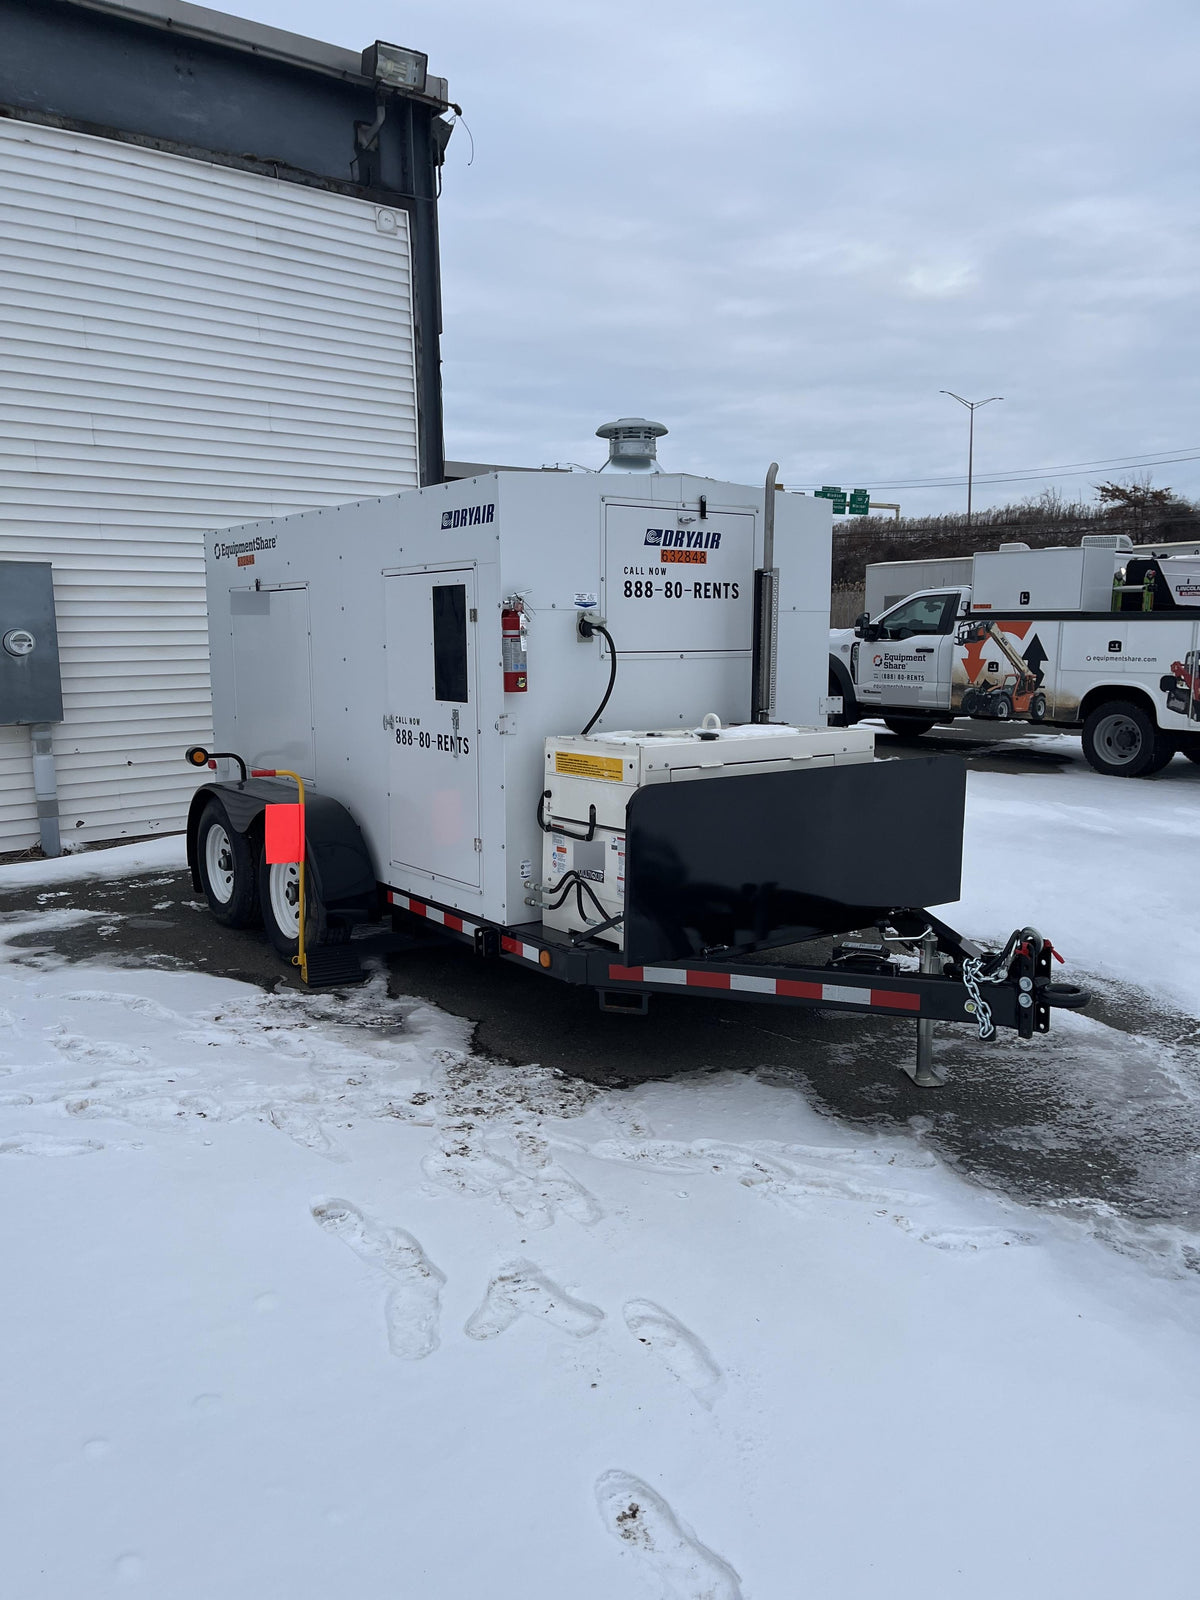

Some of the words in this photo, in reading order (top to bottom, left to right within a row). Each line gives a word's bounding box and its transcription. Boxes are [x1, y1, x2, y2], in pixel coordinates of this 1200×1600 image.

[453, 503, 495, 528] DRYAIR
[662, 529, 722, 549] DRYAIR
[221, 536, 276, 558] EquipmentShare
[662, 550, 707, 563] 632848
[623, 566, 645, 575] CALL
[648, 567, 667, 575] NOW
[623, 580, 740, 599] 888-80-RENTS
[884, 653, 926, 662] Equipment
[1092, 655, 1157, 663] equipmentshare.com
[883, 661, 906, 669] Share
[395, 715, 407, 724] CALL
[409, 717, 420, 726] NOW
[395, 728, 469, 755] 888-80-RENTS
